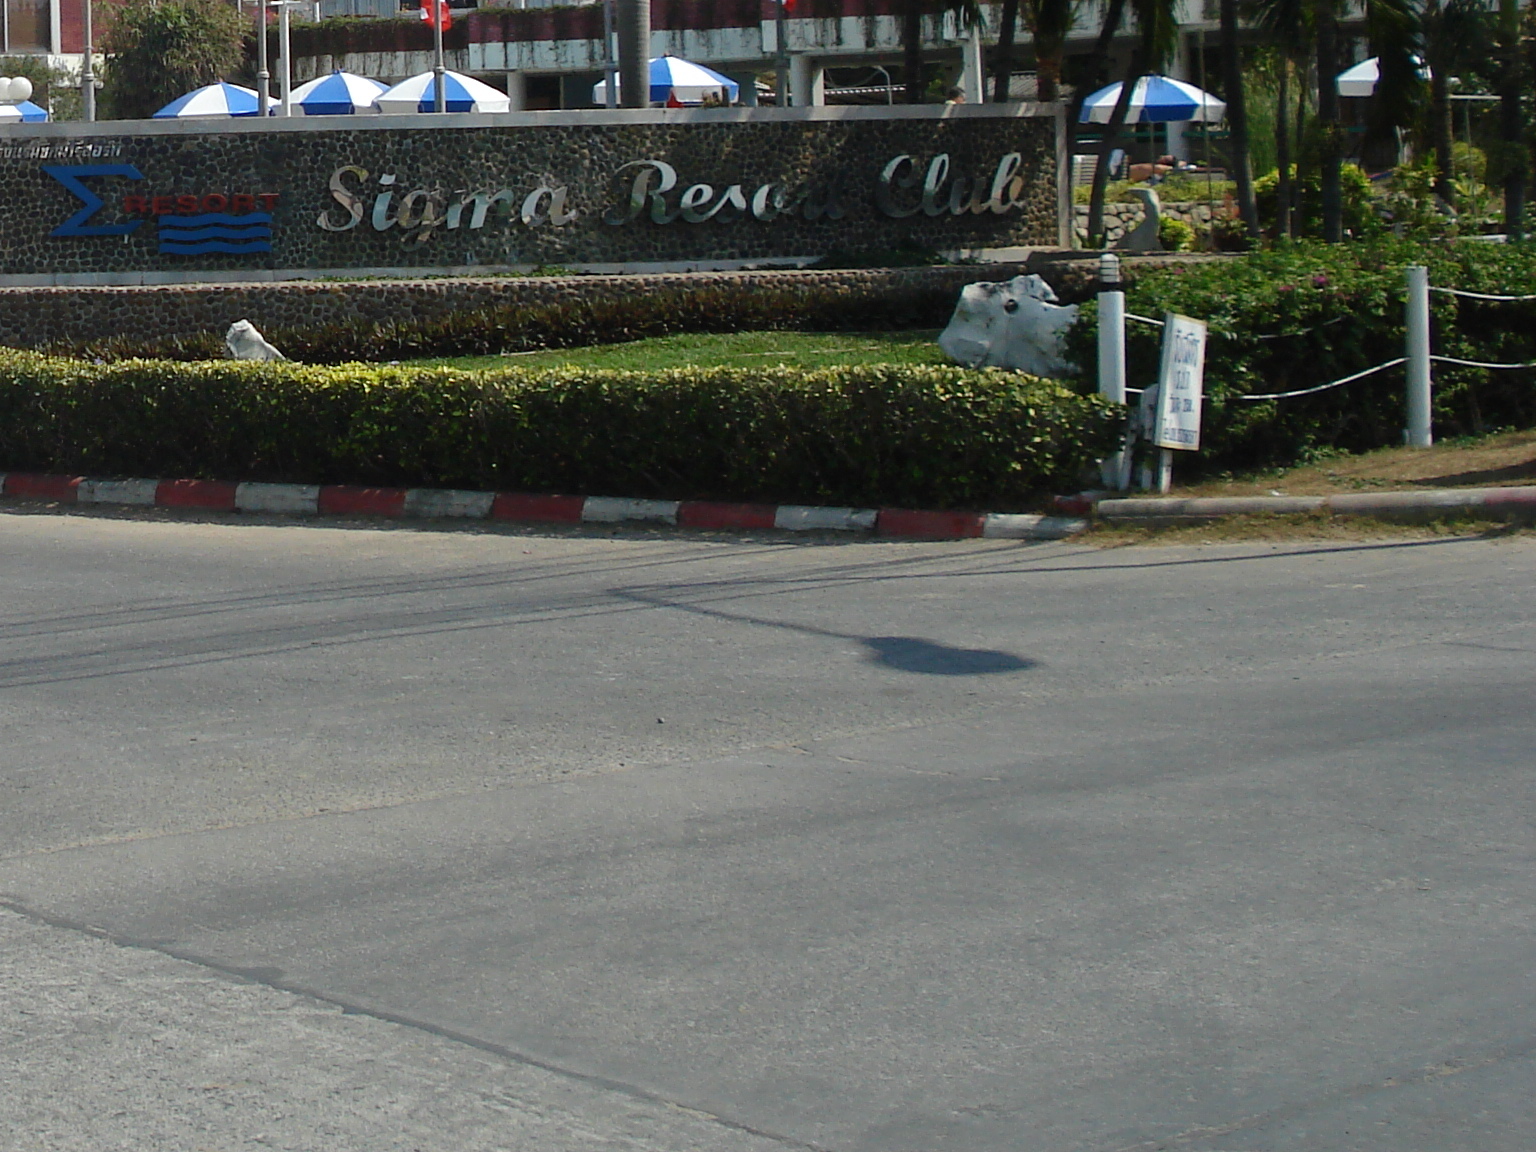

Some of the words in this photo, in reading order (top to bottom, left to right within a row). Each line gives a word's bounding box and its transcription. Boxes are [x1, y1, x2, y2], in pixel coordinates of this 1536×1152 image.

[123, 193, 280, 215] RESORT
[316, 165, 578, 252] Sigma
[877, 152, 1028, 219] Club
